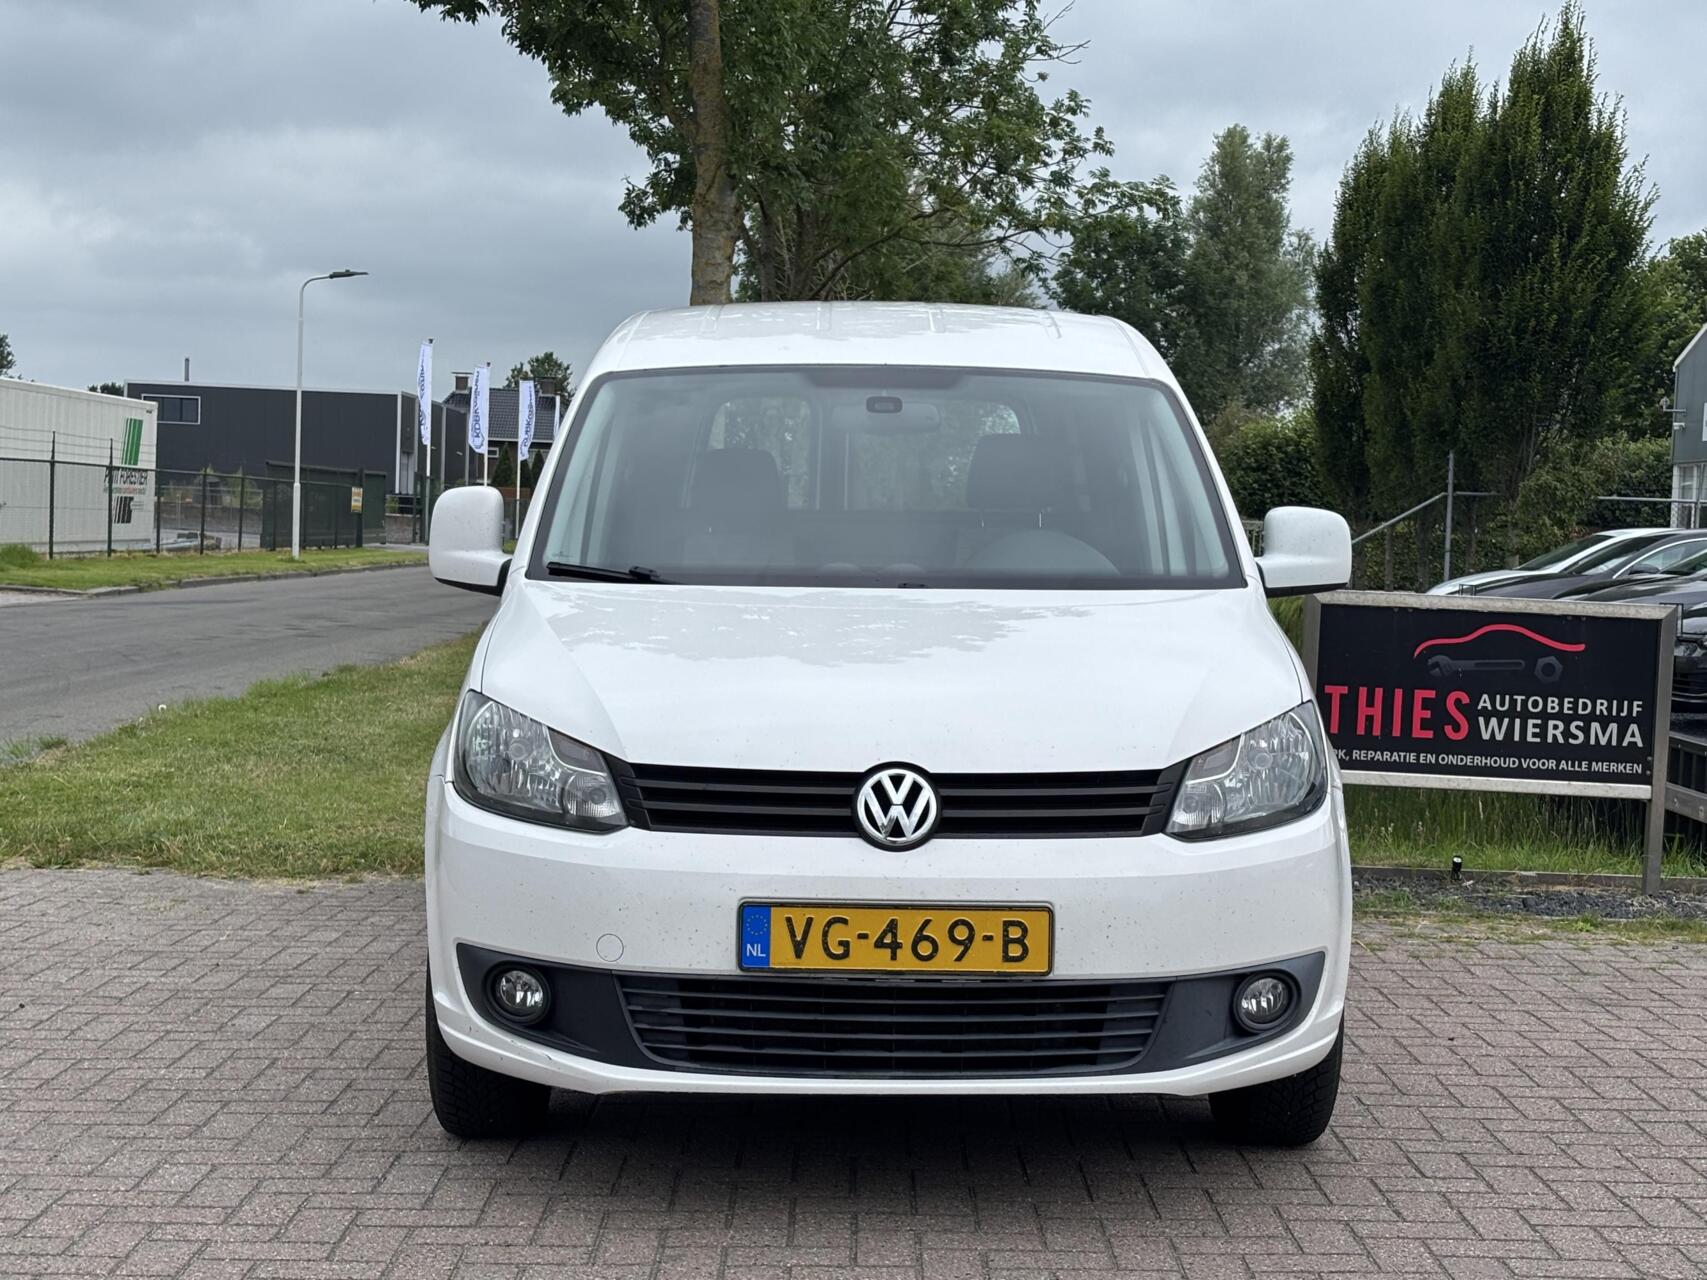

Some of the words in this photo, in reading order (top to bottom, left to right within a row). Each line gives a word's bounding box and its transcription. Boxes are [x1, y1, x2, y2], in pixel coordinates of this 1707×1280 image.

[1324, 685, 1470, 741] THIES
[1477, 693, 1644, 717] AUTOBEDRIJF
[1478, 716, 1644, 748] WIERSMA
[1352, 749, 1417, 764] REPARATIE
[1419, 753, 1436, 765] EN
[1438, 754, 1519, 769] ONDERHOUD
[1520, 757, 1557, 771] VOOR
[1559, 758, 1588, 772] ALLE
[1591, 760, 1642, 775] MERKEN
[860, 771, 935, 844] VW
[746, 944, 766, 958] NL
[785, 916, 1030, 963] VG-469-B
